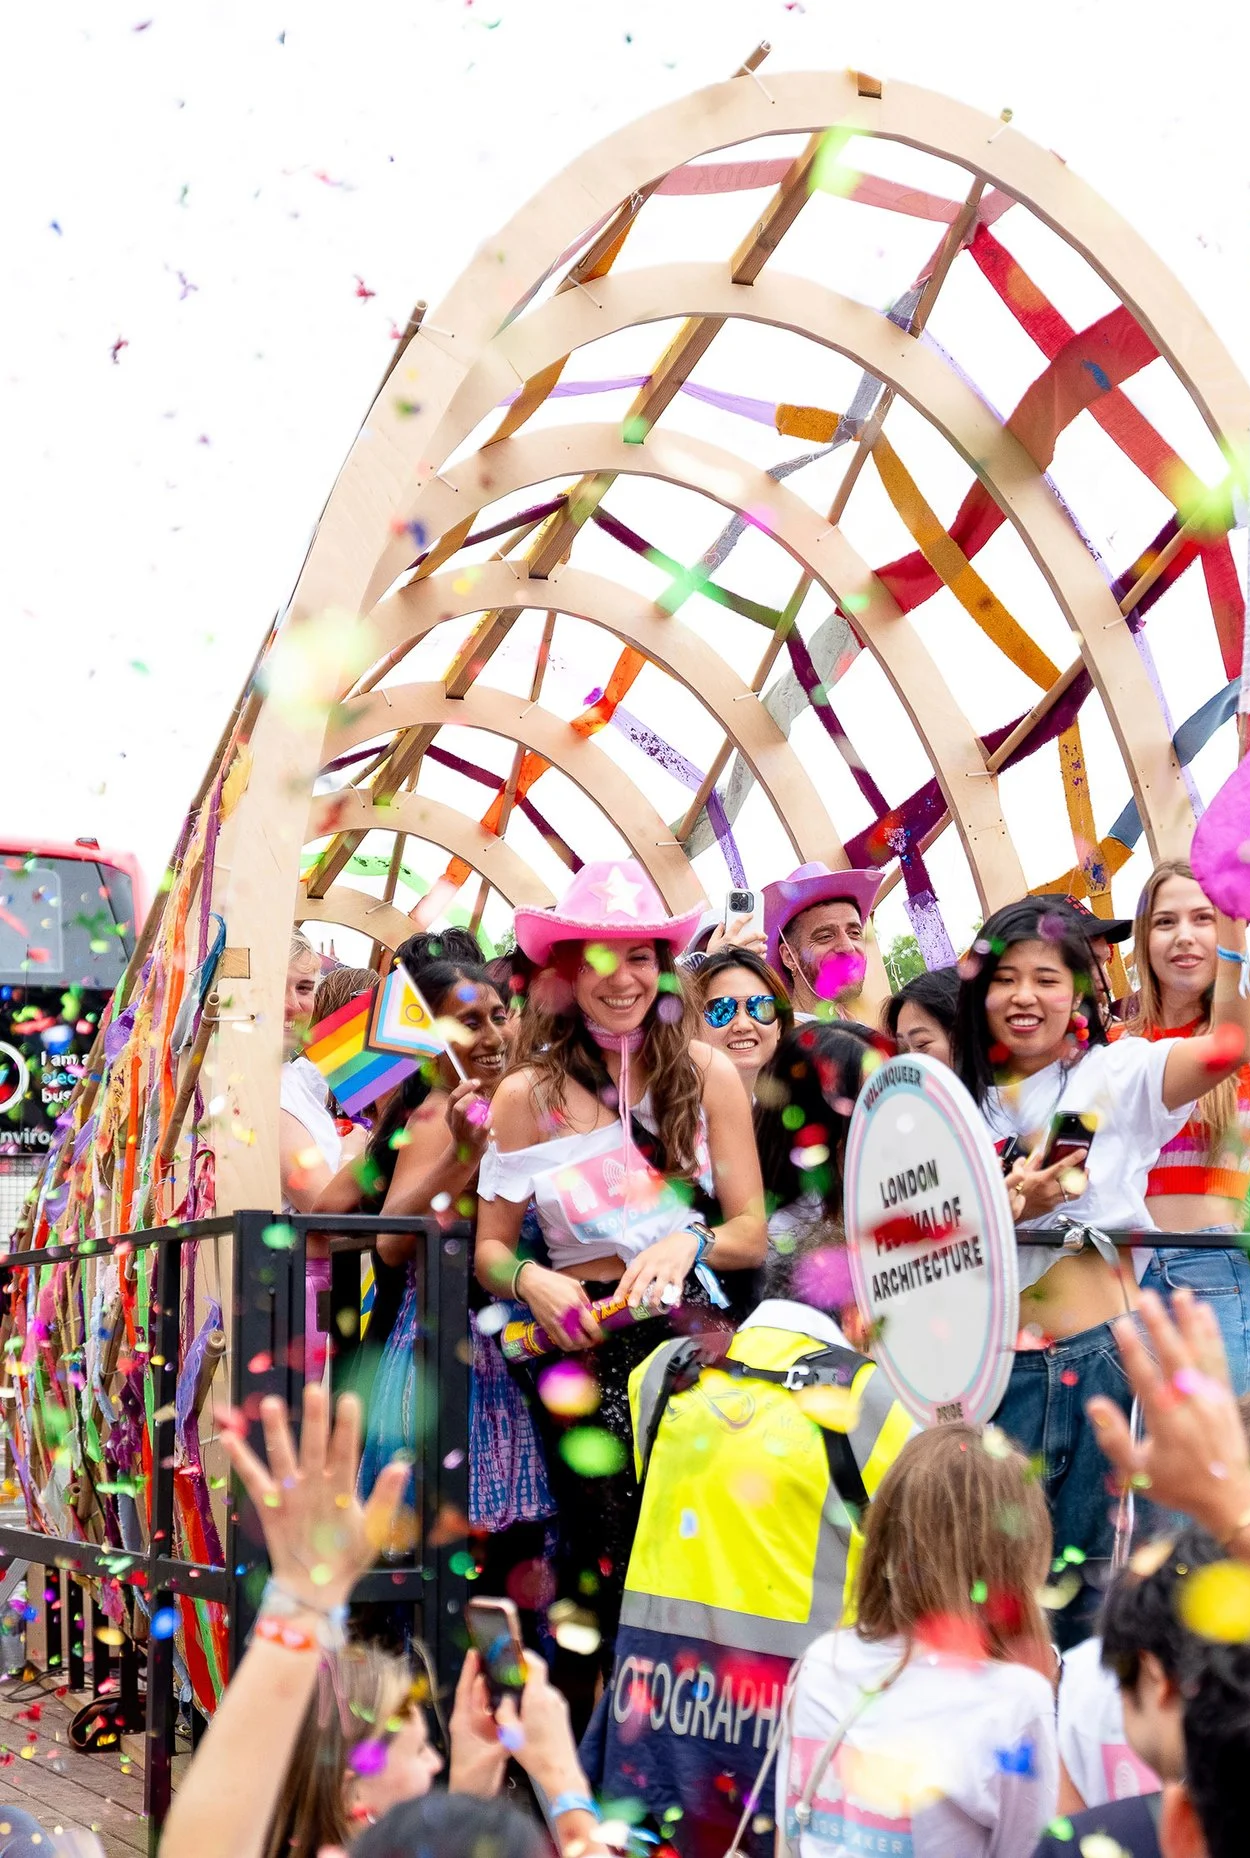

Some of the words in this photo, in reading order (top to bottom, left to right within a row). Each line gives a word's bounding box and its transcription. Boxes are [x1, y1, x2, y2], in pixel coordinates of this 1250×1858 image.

[41, 1070, 77, 1086] elec
[51, 1054, 78, 1067] am
[880, 1159, 939, 1208] LONDON
[943, 1196, 962, 1228] OF
[872, 1236, 983, 1302] ARCHITECTURE
[610, 1655, 785, 1749] OTOGRAPH
